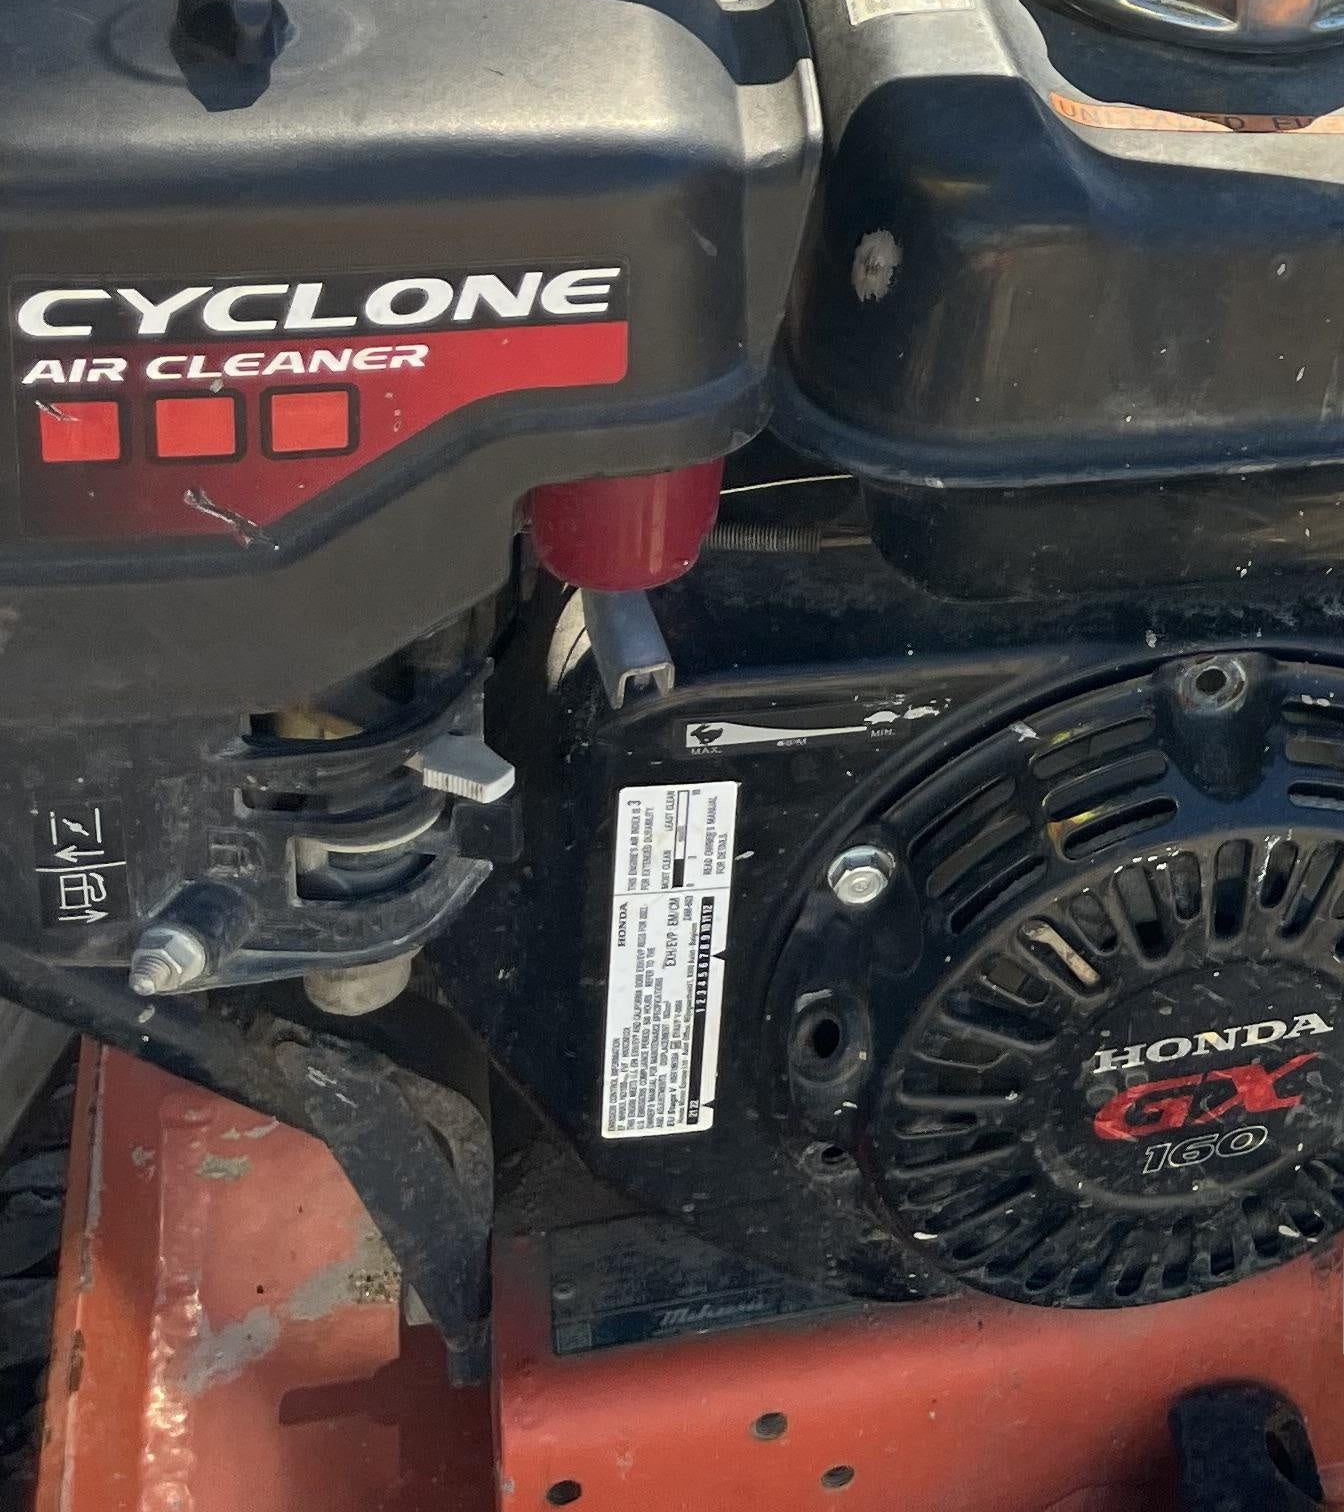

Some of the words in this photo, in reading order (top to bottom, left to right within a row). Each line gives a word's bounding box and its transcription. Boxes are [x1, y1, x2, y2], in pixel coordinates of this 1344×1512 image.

[17, 267, 621, 338] CYCLONE
[22, 357, 128, 384] AIR
[145, 344, 430, 379] CLEANER
[617, 902, 628, 948] HONDA
[1092, 1012, 1333, 1073] HONDA
[1094, 1051, 1325, 1141] GX
[1141, 1125, 1268, 1174] 160
